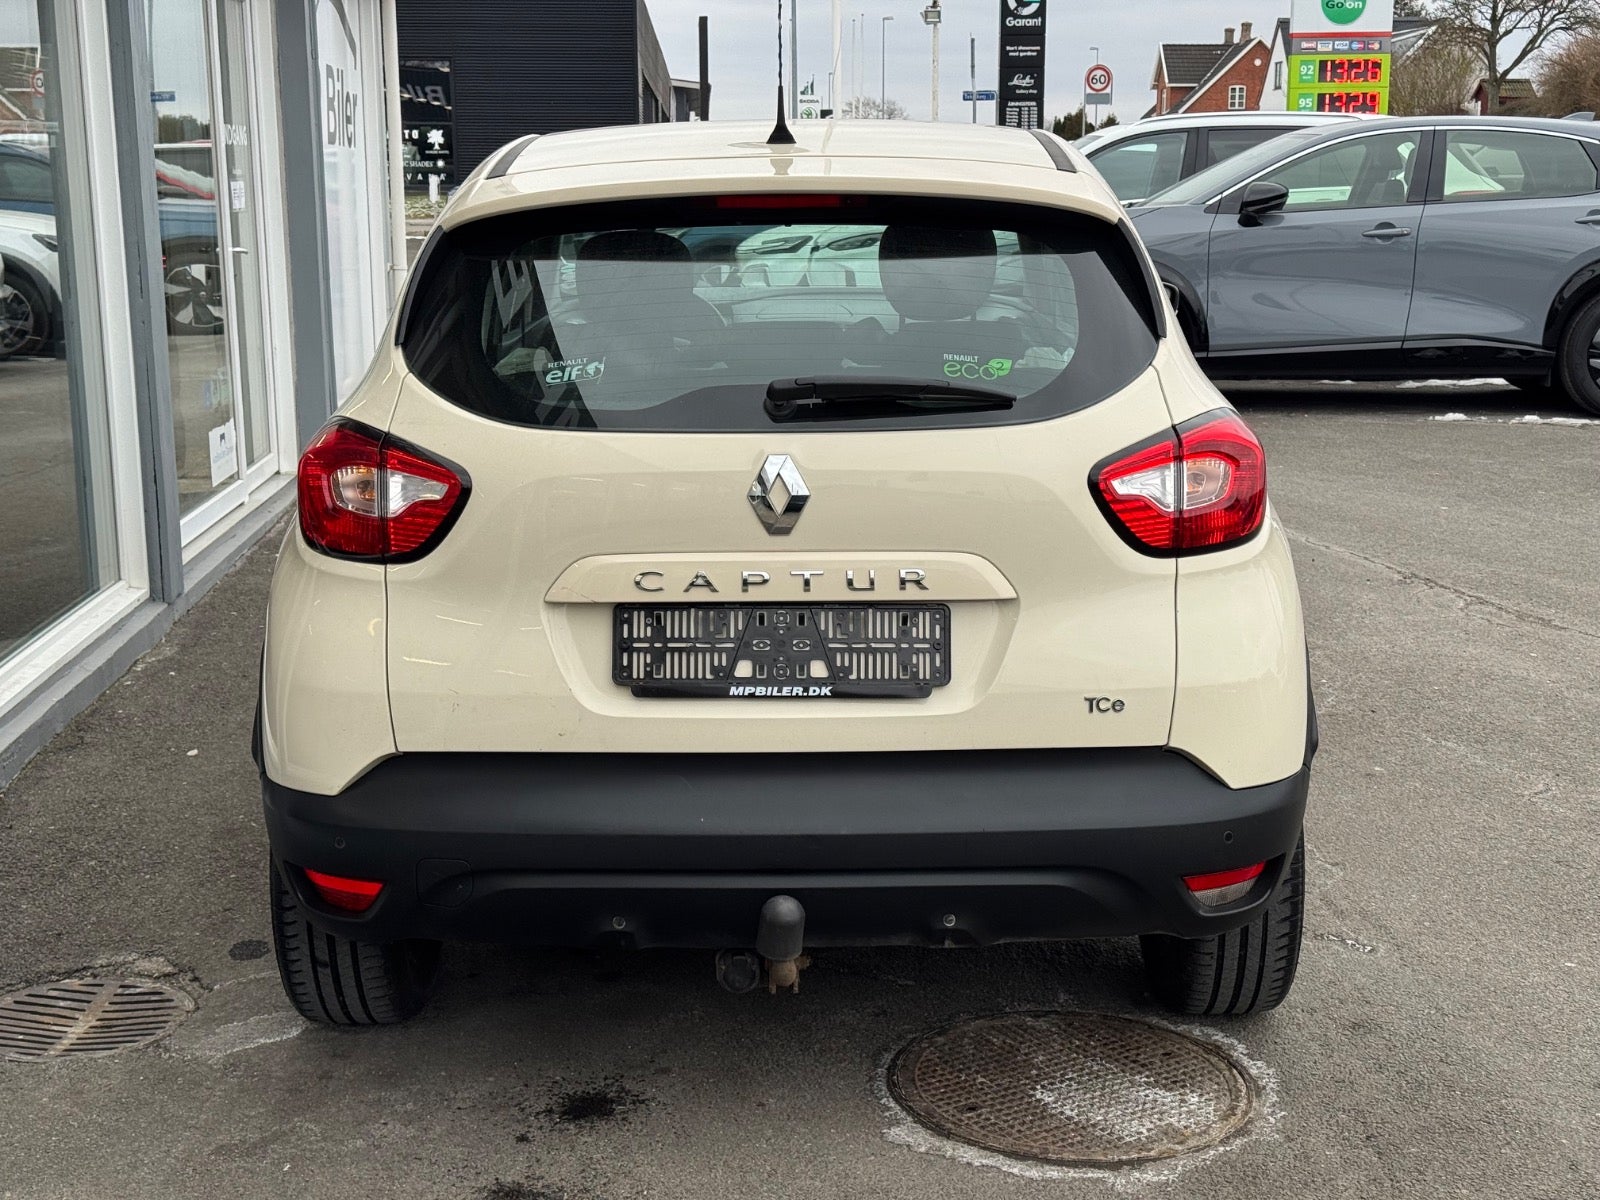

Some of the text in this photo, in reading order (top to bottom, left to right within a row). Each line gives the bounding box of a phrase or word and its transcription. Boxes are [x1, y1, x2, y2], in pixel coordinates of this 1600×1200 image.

[1005, 16, 1042, 27] Garant
[1300, 65, 1314, 75] 92
[1091, 74, 1107, 85] 60
[326, 63, 357, 149] Biler
[1299, 98, 1313, 108] 95
[547, 357, 589, 369] RENAULT
[943, 353, 980, 363] RENAULT
[545, 365, 583, 384] elf
[633, 568, 930, 593] CAPTUR
[728, 685, 833, 697] MPBILER.DK
[1083, 696, 1125, 714] TCe
